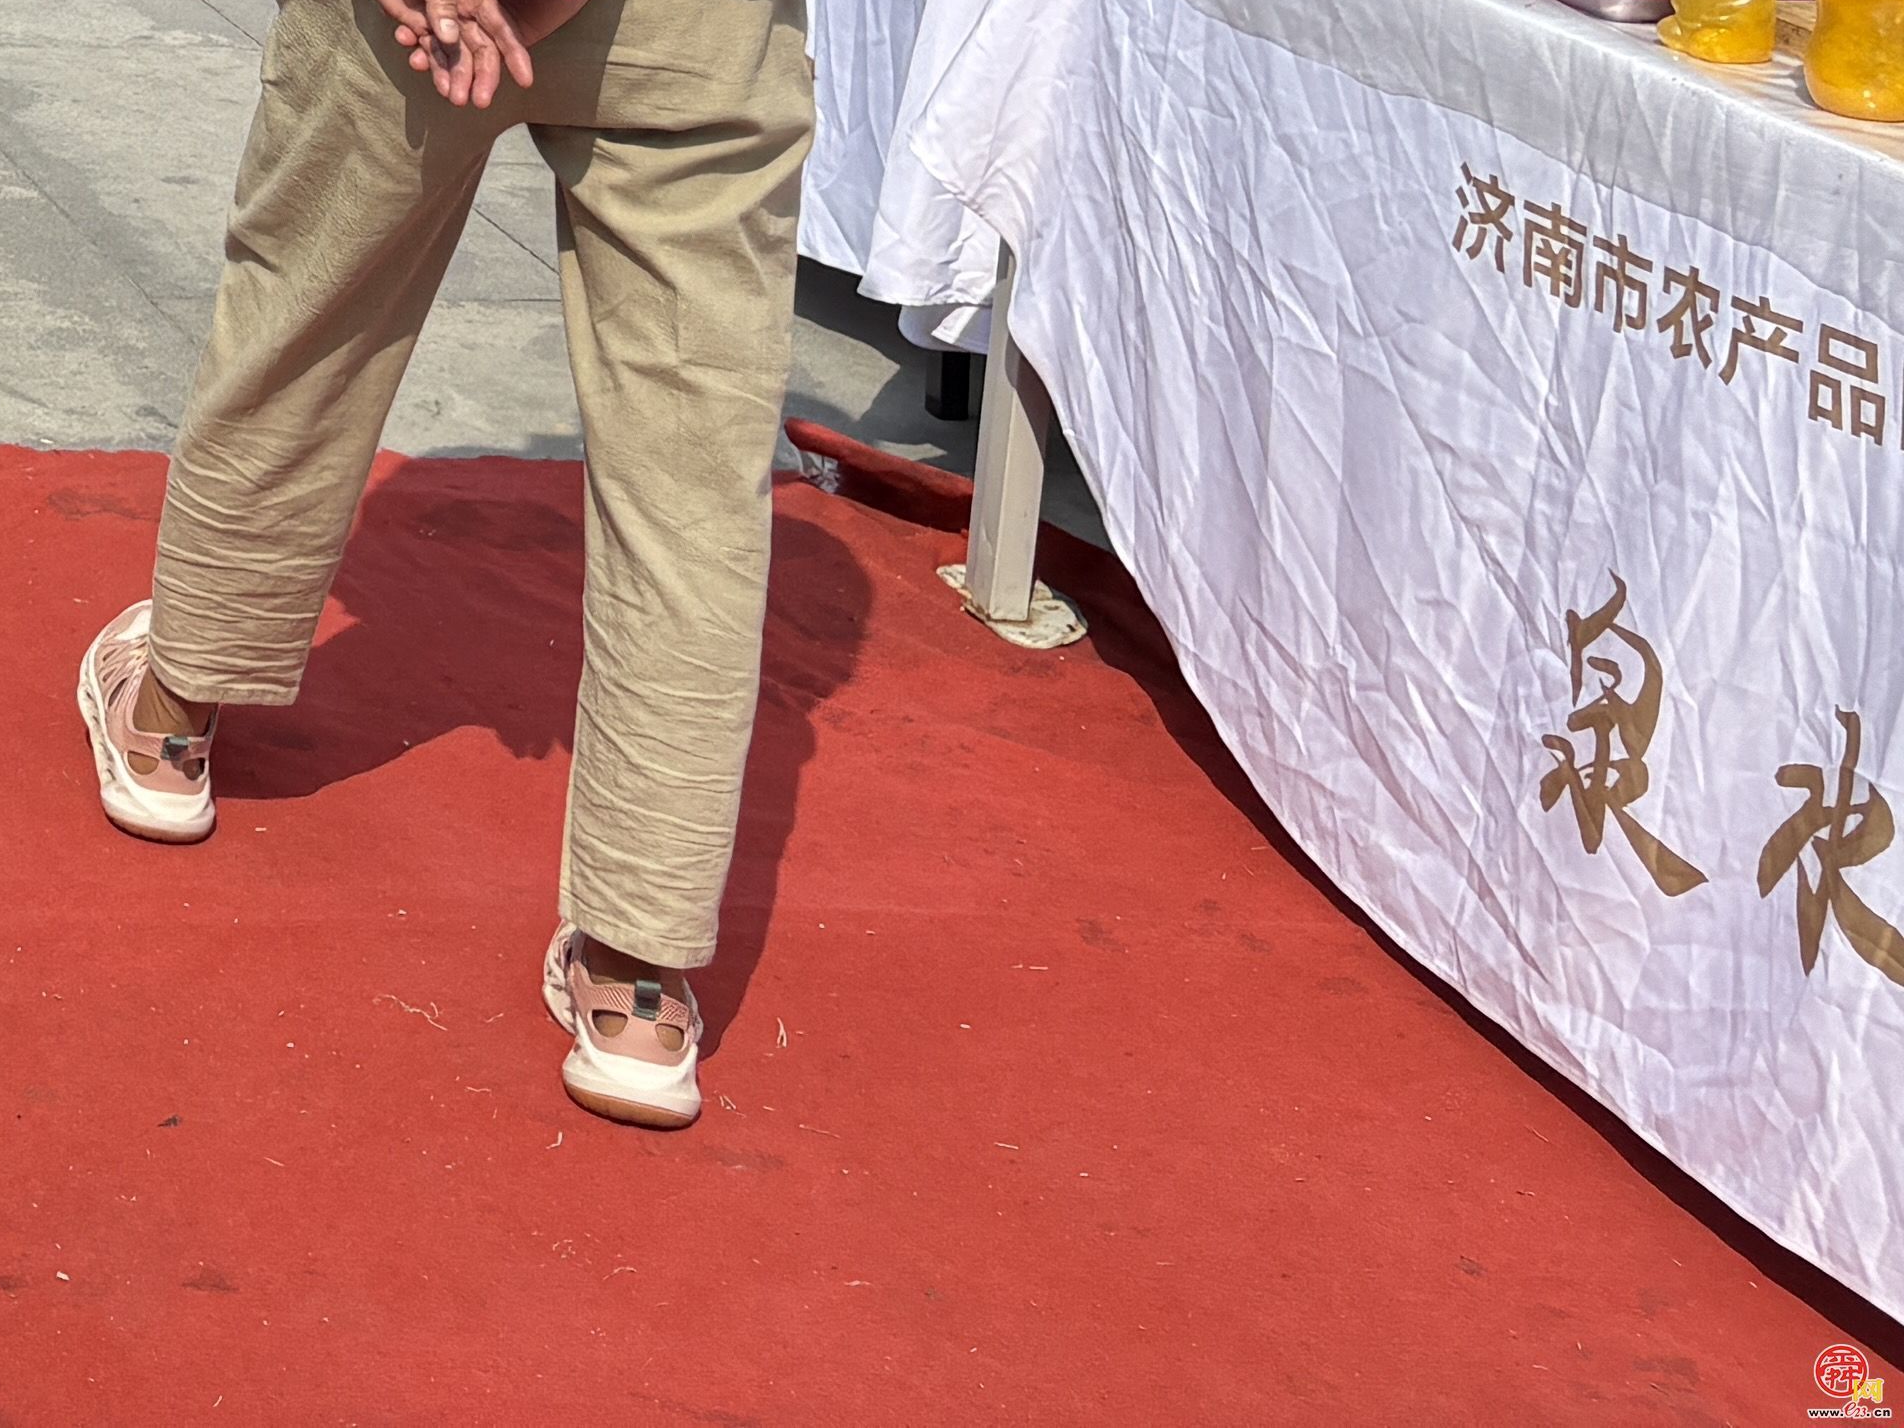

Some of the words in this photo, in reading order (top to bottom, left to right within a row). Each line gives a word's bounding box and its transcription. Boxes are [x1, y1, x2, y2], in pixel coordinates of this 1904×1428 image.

[1451, 160, 1904, 450] 济南市农产品
